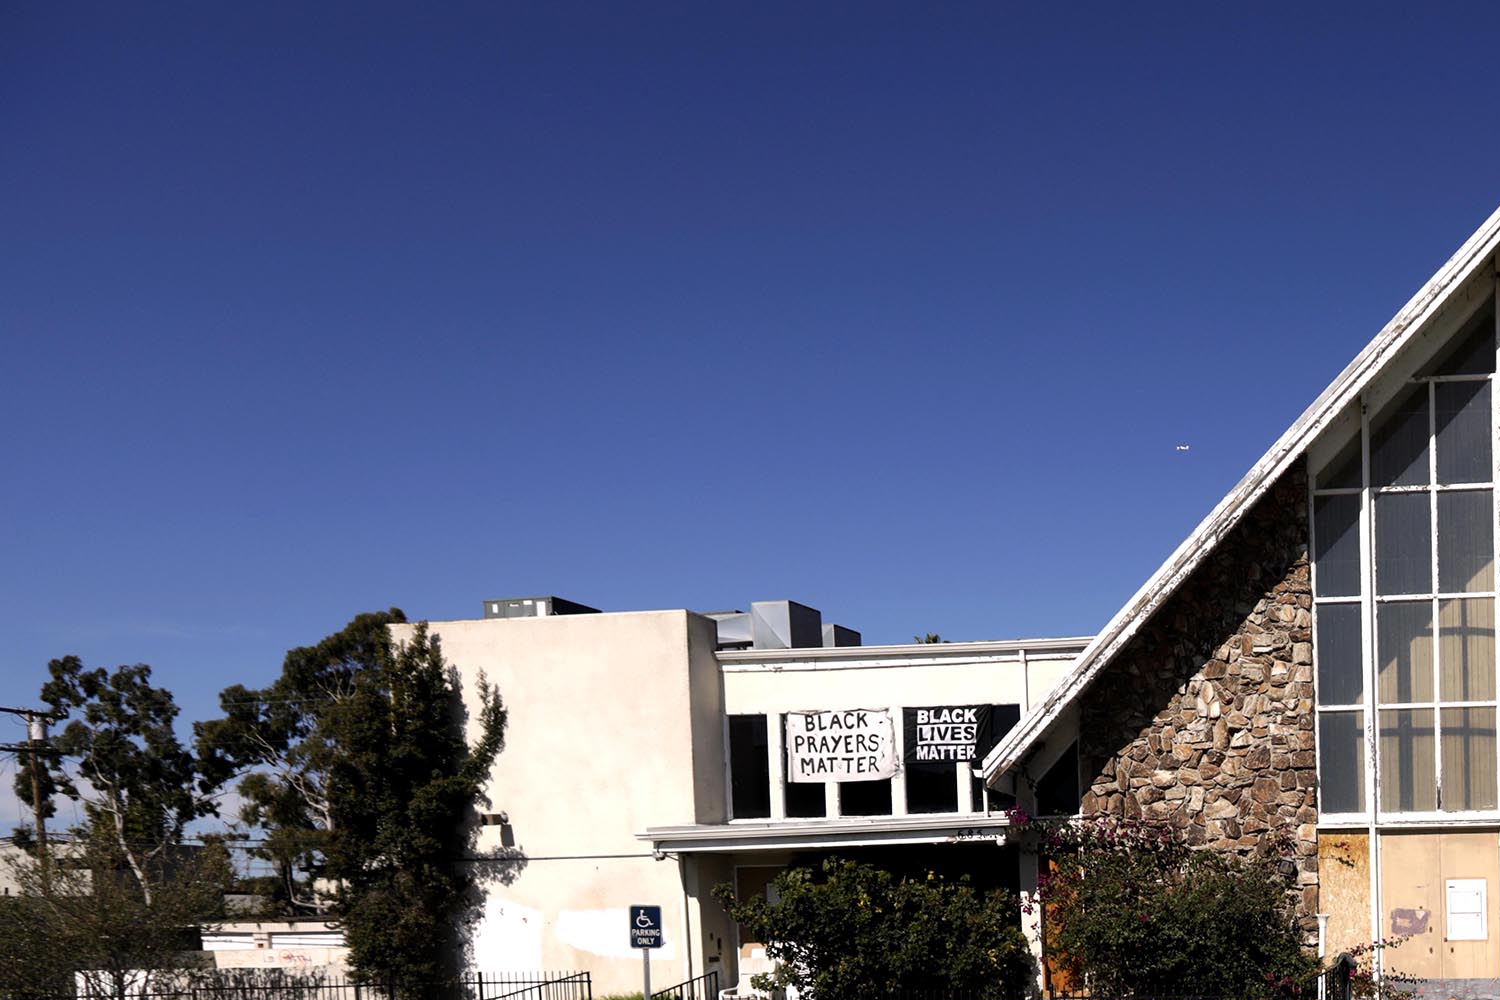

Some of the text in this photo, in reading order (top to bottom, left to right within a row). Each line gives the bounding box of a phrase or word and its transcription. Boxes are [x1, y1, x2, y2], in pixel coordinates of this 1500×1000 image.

[804, 712, 869, 732] BLACK
[917, 708, 977, 724] BLACK
[918, 725, 976, 742] LIVES
[794, 733, 880, 754] PRAYERS
[916, 745, 977, 761] MATTER
[800, 756, 880, 774] MATTER
[631, 928, 661, 937] PARKING
[637, 937, 655, 945] ONLY
